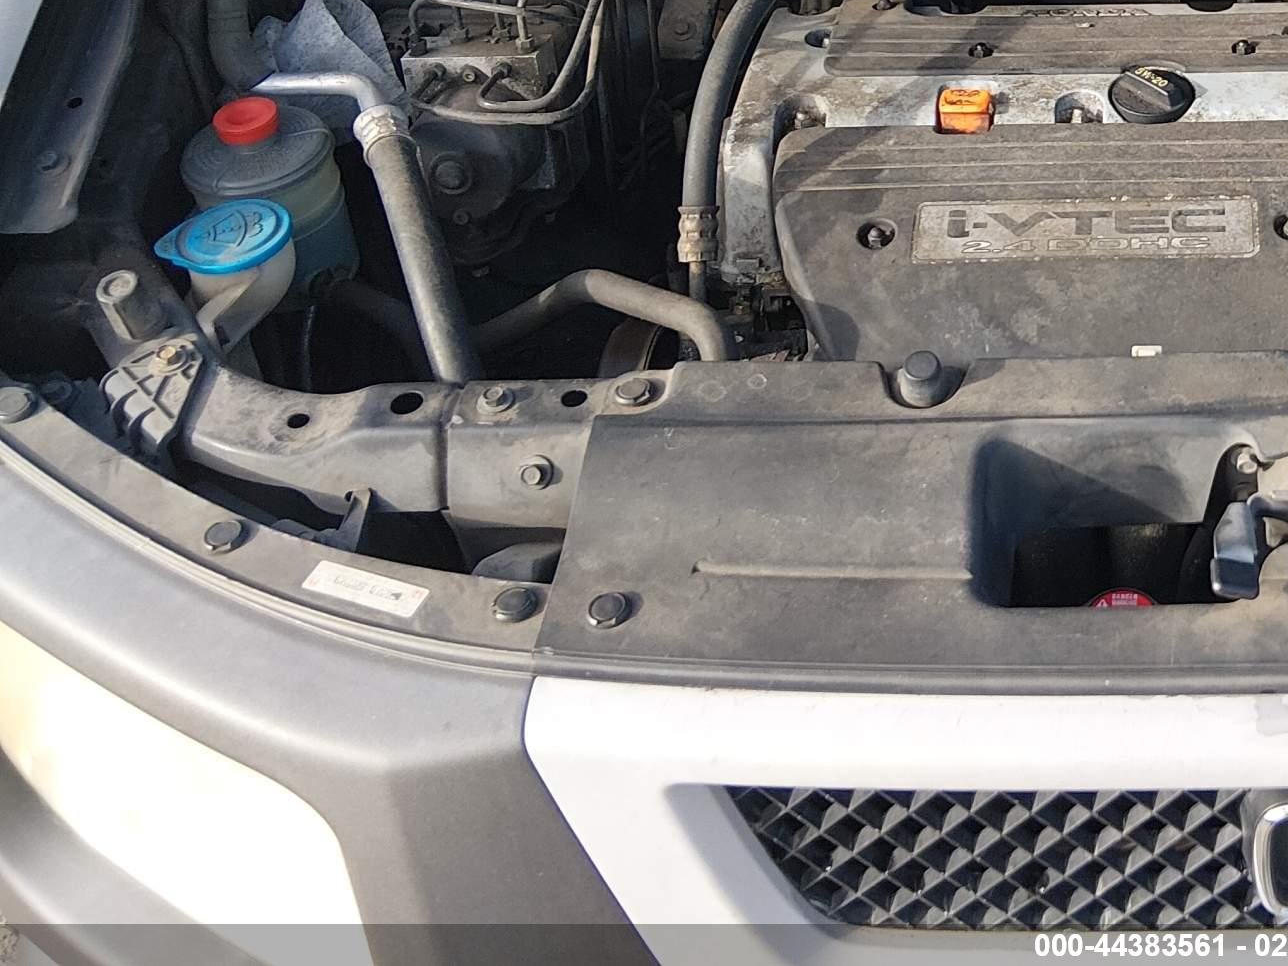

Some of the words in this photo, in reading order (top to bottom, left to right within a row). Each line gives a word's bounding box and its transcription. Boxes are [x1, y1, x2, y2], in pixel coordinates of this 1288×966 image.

[947, 208, 1226, 238] i-VTEC
[961, 239, 1036, 253] 2.4
[1047, 236, 1211, 252] DOHC
